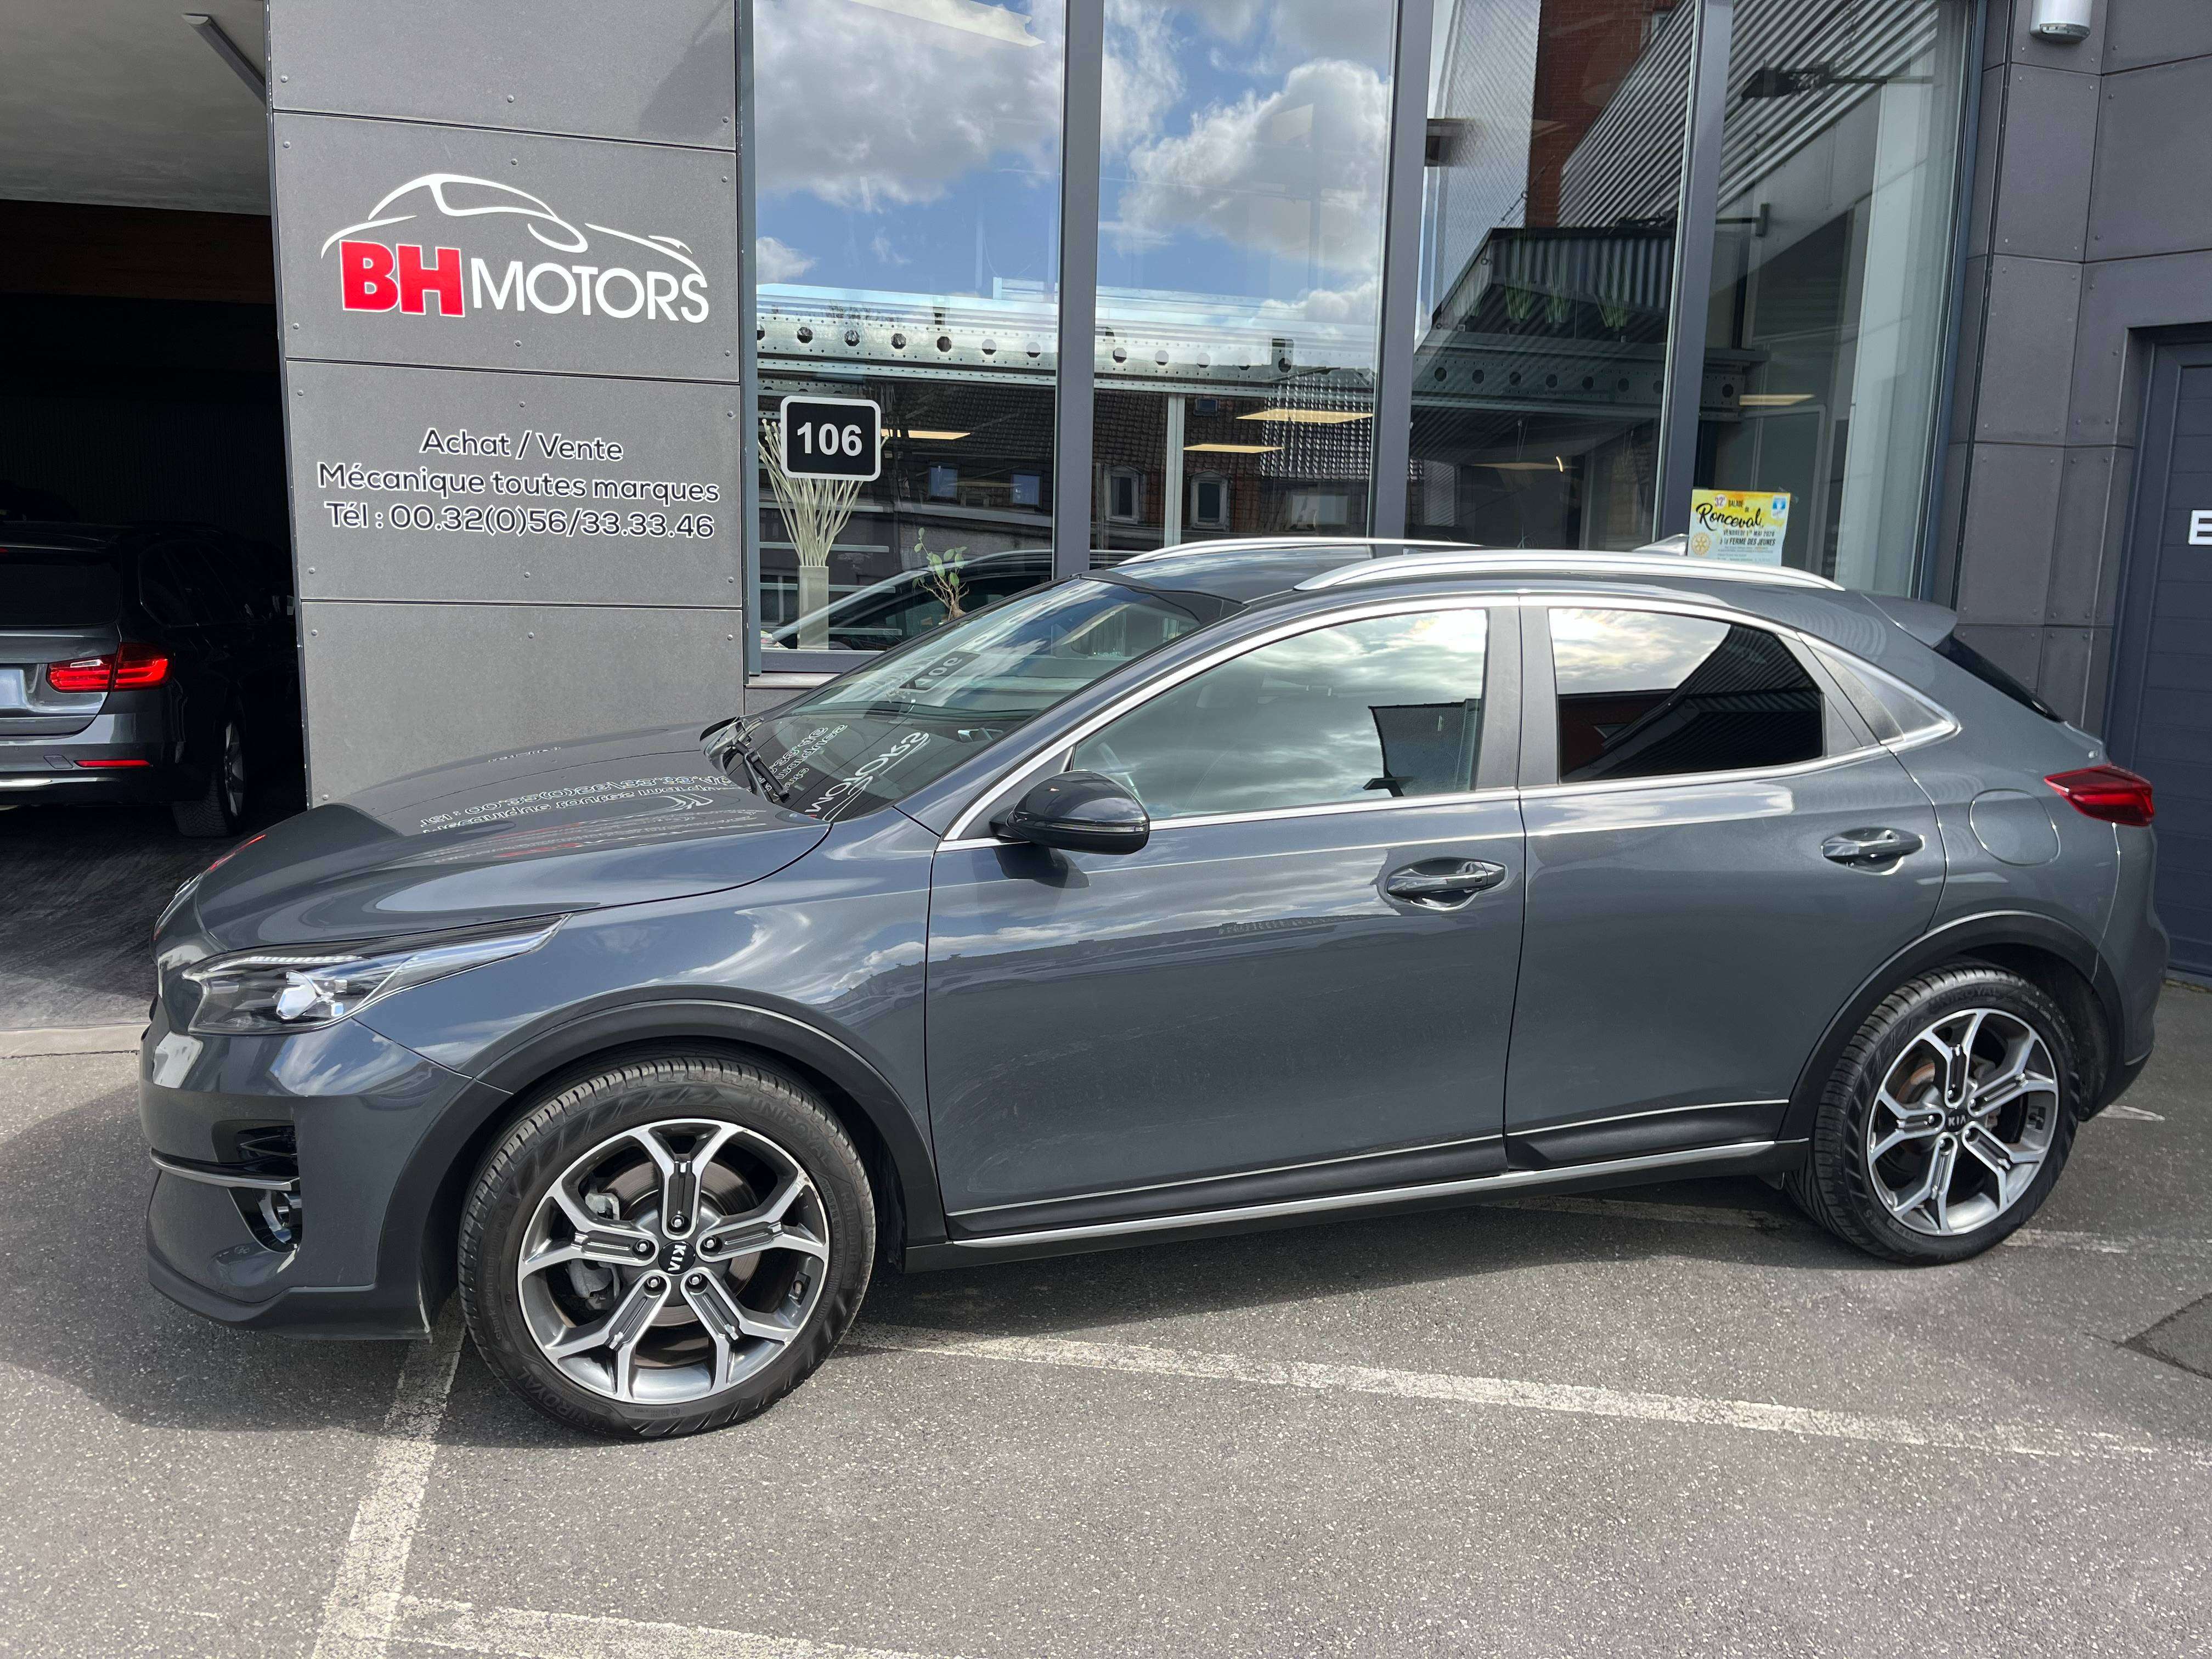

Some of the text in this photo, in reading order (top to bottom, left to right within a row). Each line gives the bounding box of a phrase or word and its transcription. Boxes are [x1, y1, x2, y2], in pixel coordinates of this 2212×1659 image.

[339, 239, 710, 324] BH MOTORS
[419, 427, 624, 462] Achat / Vente
[797, 422, 862, 457] 106
[317, 462, 720, 508] Mécanique toutes marques
[324, 500, 715, 541] Tél : 00.32(0)56/33.33.46
[1729, 537, 1746, 545] FERME
[1948, 1115, 1967, 1126] KIA
[667, 1244, 687, 1272] KIA
